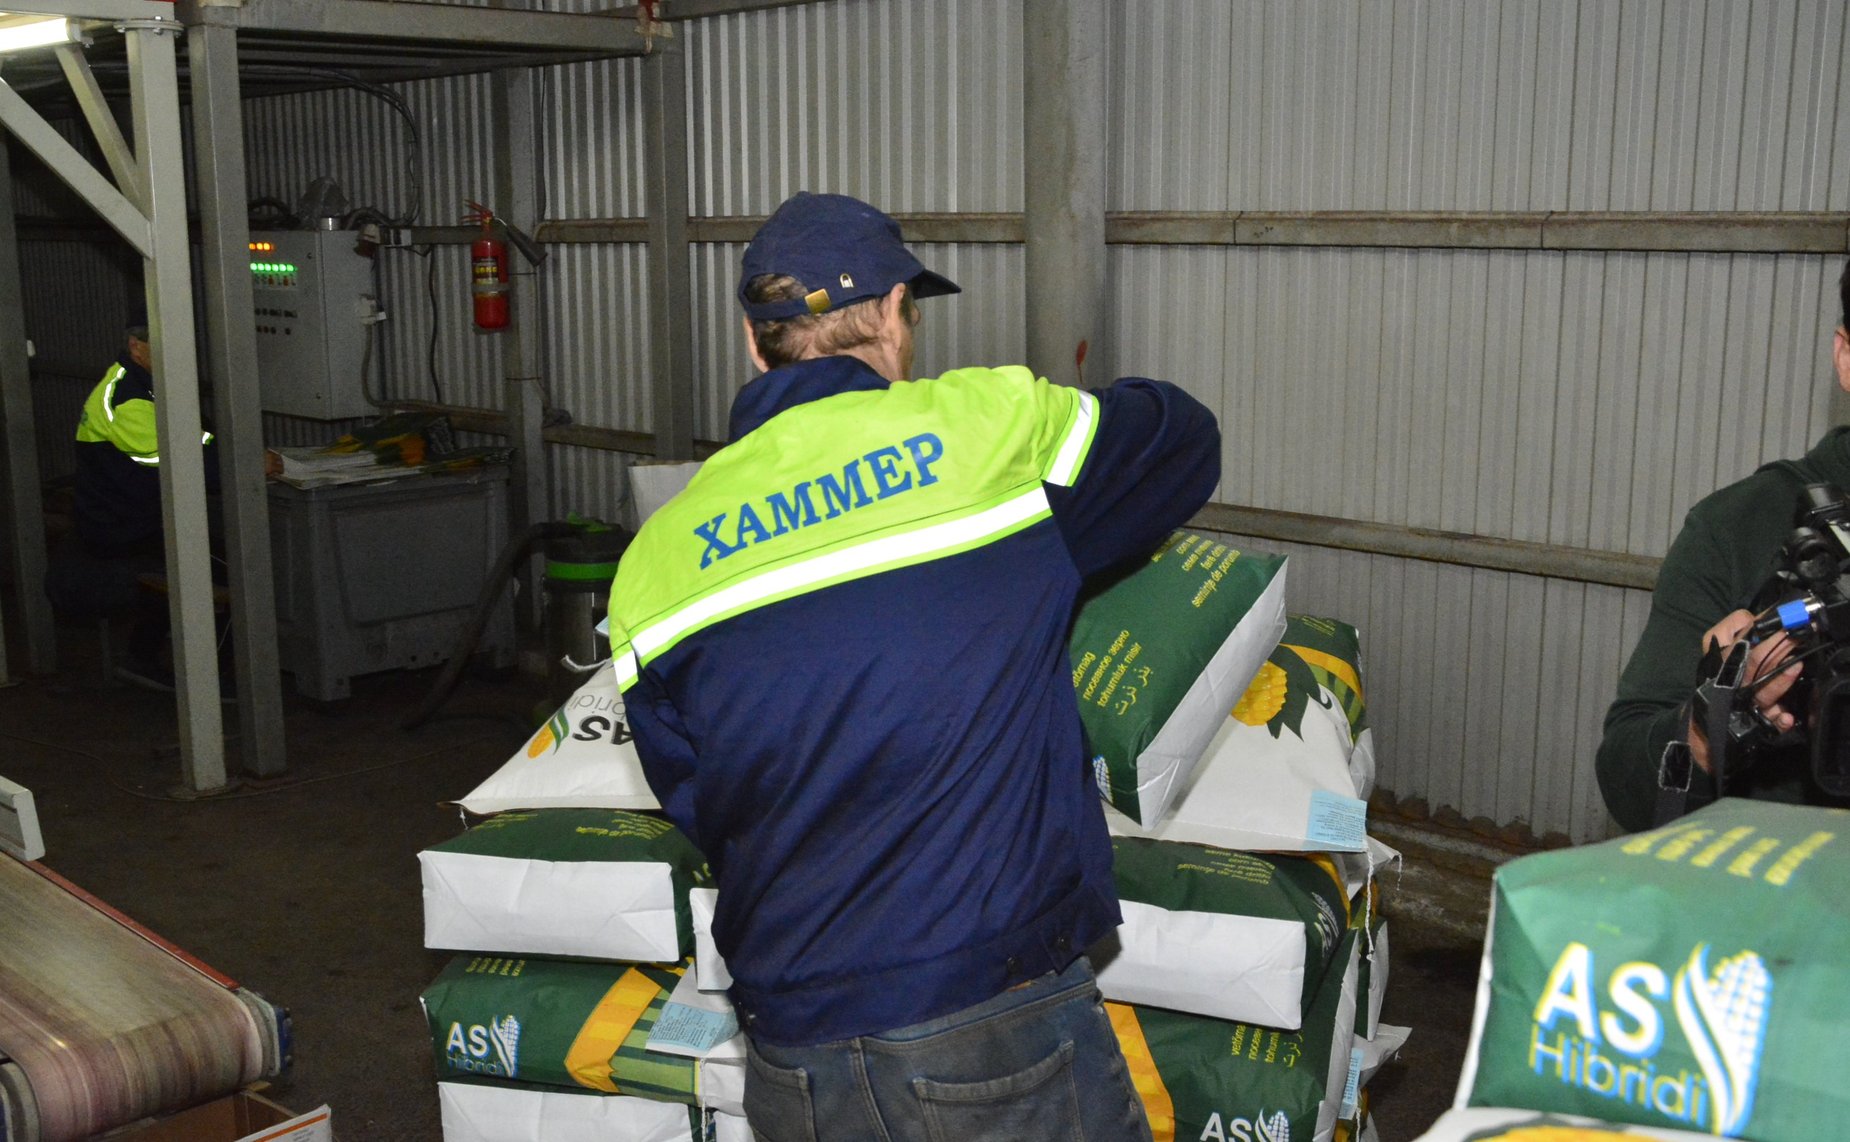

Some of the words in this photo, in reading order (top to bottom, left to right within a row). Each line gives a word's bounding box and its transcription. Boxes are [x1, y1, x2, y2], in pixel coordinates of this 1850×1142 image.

[1533, 941, 1671, 1059] AS
[446, 1021, 490, 1059] AS
[1529, 1023, 1708, 1128] Hibridi
[1199, 1111, 1252, 1142] AS
